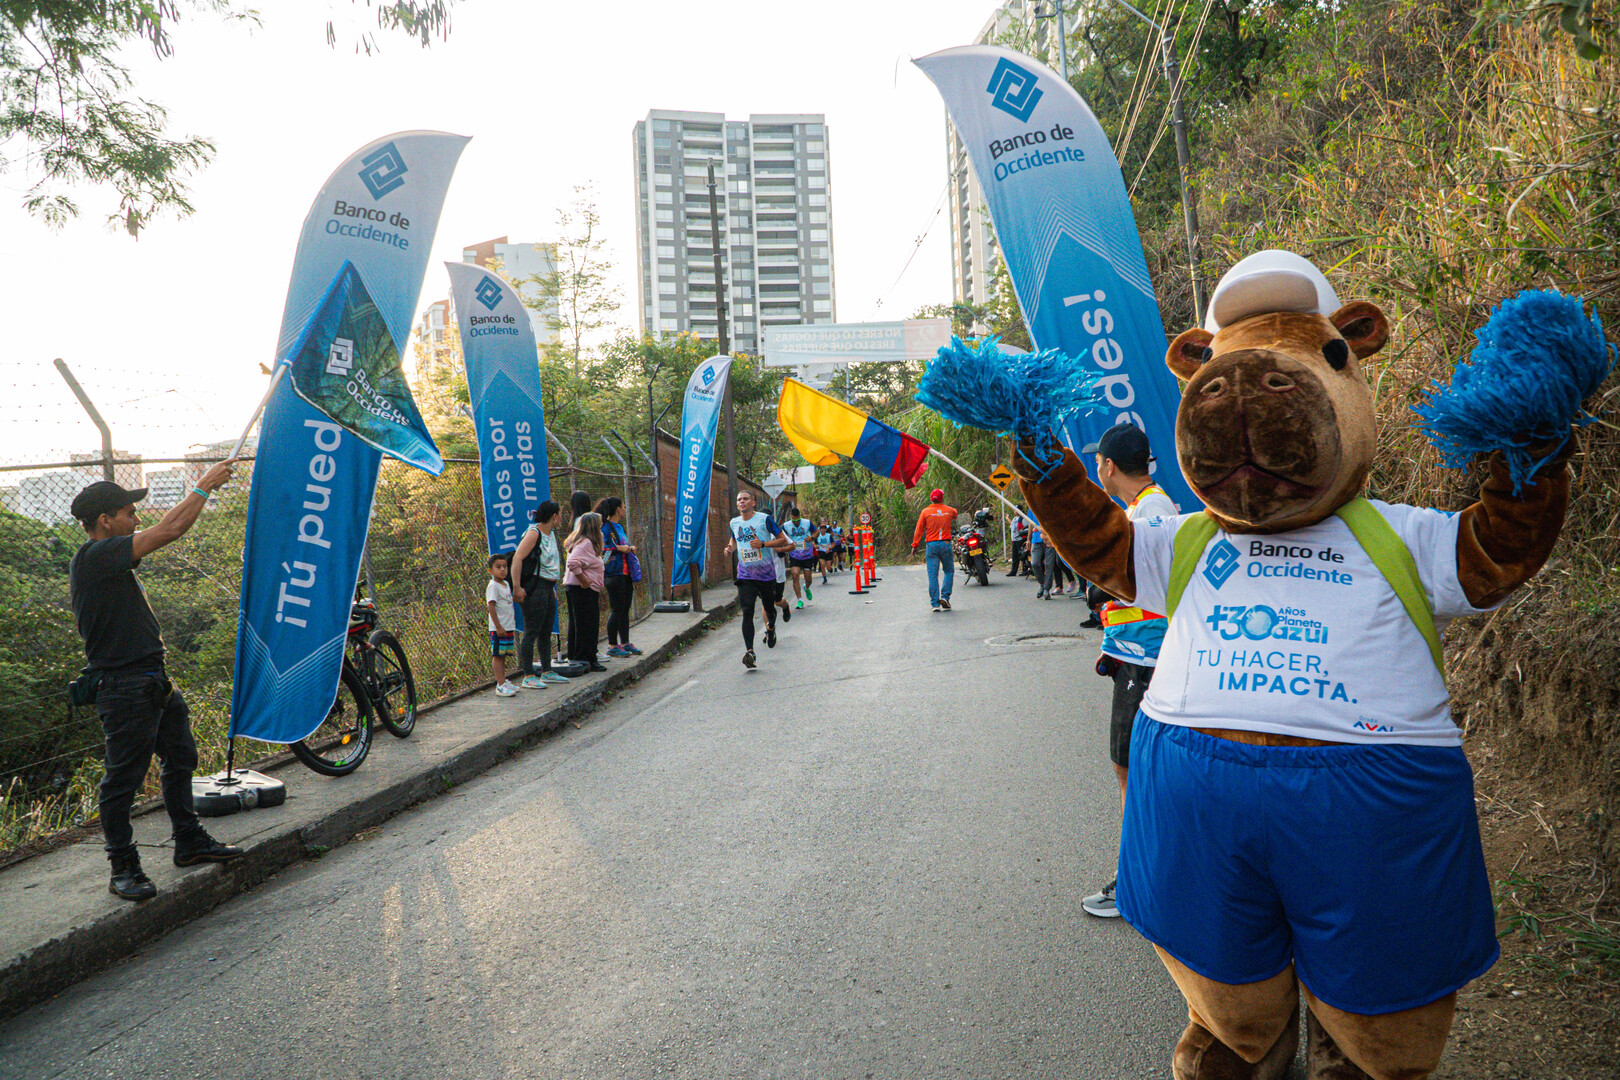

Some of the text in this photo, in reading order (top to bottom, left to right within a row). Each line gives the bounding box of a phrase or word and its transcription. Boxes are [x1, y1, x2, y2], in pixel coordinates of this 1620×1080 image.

[988, 123, 1075, 160] Banco de
[993, 146, 1086, 182] Occidente
[333, 200, 410, 231] Banco de
[325, 219, 409, 251] Occidente
[470, 314, 516, 326] Banco de
[470, 325, 519, 338] Occidente
[355, 368, 391, 411] Banco
[489, 417, 514, 462] por
[515, 421, 538, 501] metas
[678, 437, 701, 549] ¡Eres fuerte!
[1249, 540, 1344, 564] Banco de
[1246, 561, 1353, 586] Occidente
[275, 560, 318, 629] ¡Tú
[1277, 615, 1322, 629] Planeta
[1278, 606, 1306, 617] AÑOS
[1271, 626, 1328, 645] azul
[1197, 649, 1329, 678] TU HACER,
[1218, 671, 1358, 704] IMPACTA.
